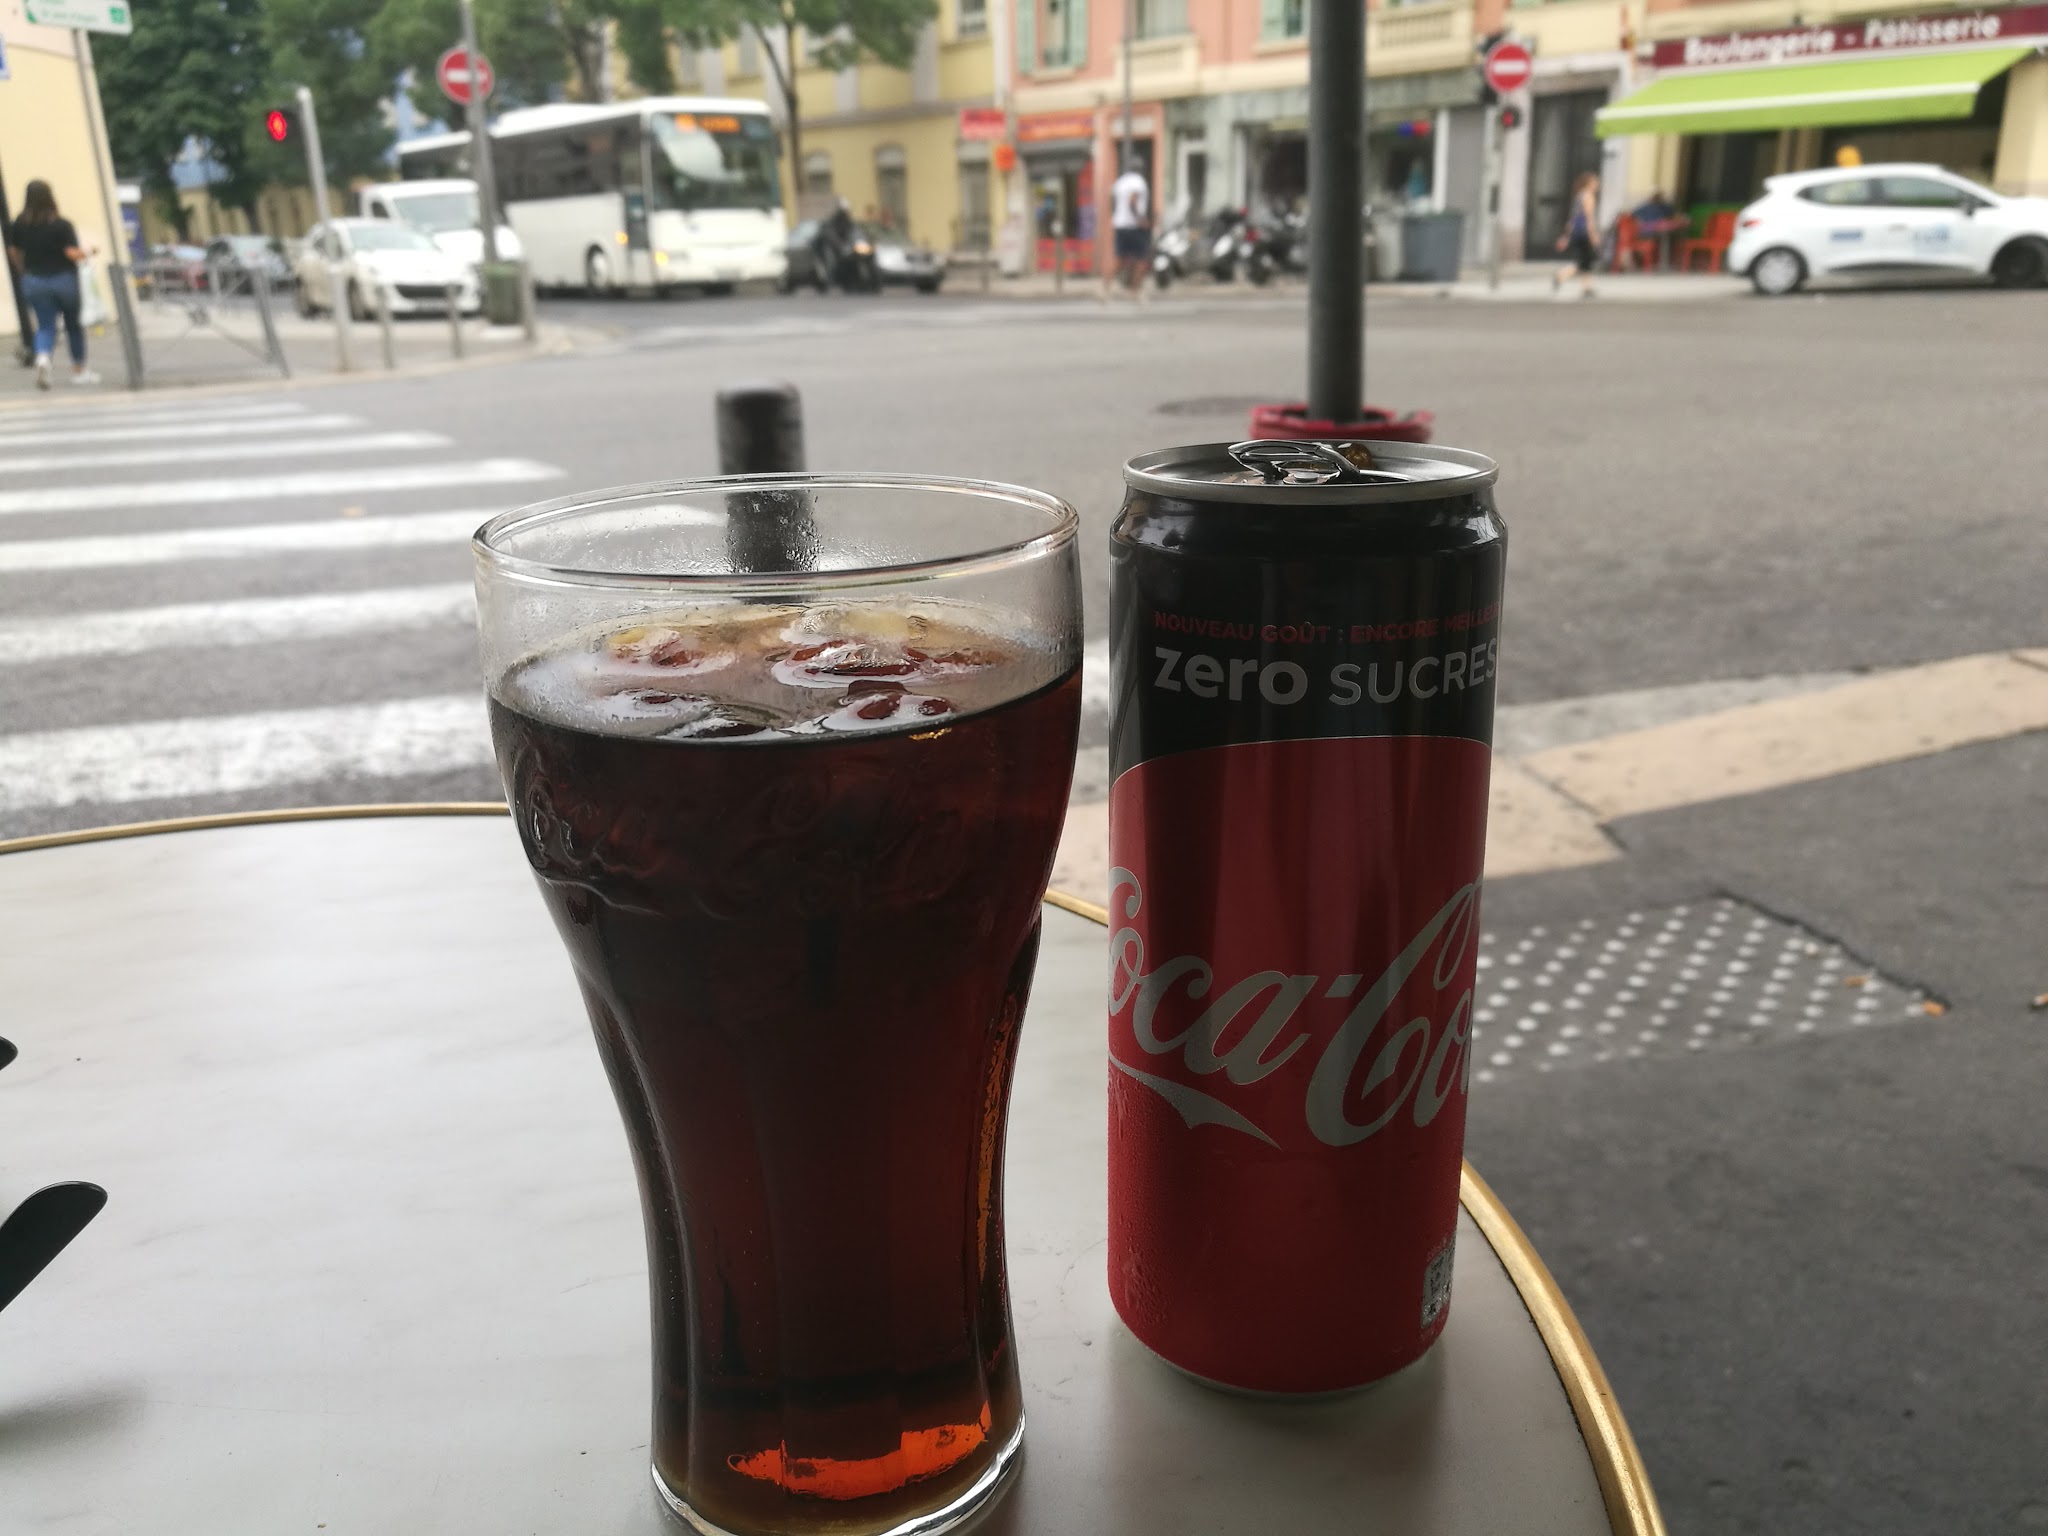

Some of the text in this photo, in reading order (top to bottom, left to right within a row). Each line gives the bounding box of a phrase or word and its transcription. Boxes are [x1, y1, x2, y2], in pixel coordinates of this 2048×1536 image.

[1683, 25, 1837, 66] Boulangerie
[1154, 609, 1254, 642] NOUVEAU
[1259, 620, 1331, 645] GOÛT
[1348, 617, 1440, 646] ENCORE
[1154, 637, 1498, 706] zero SUCRES
